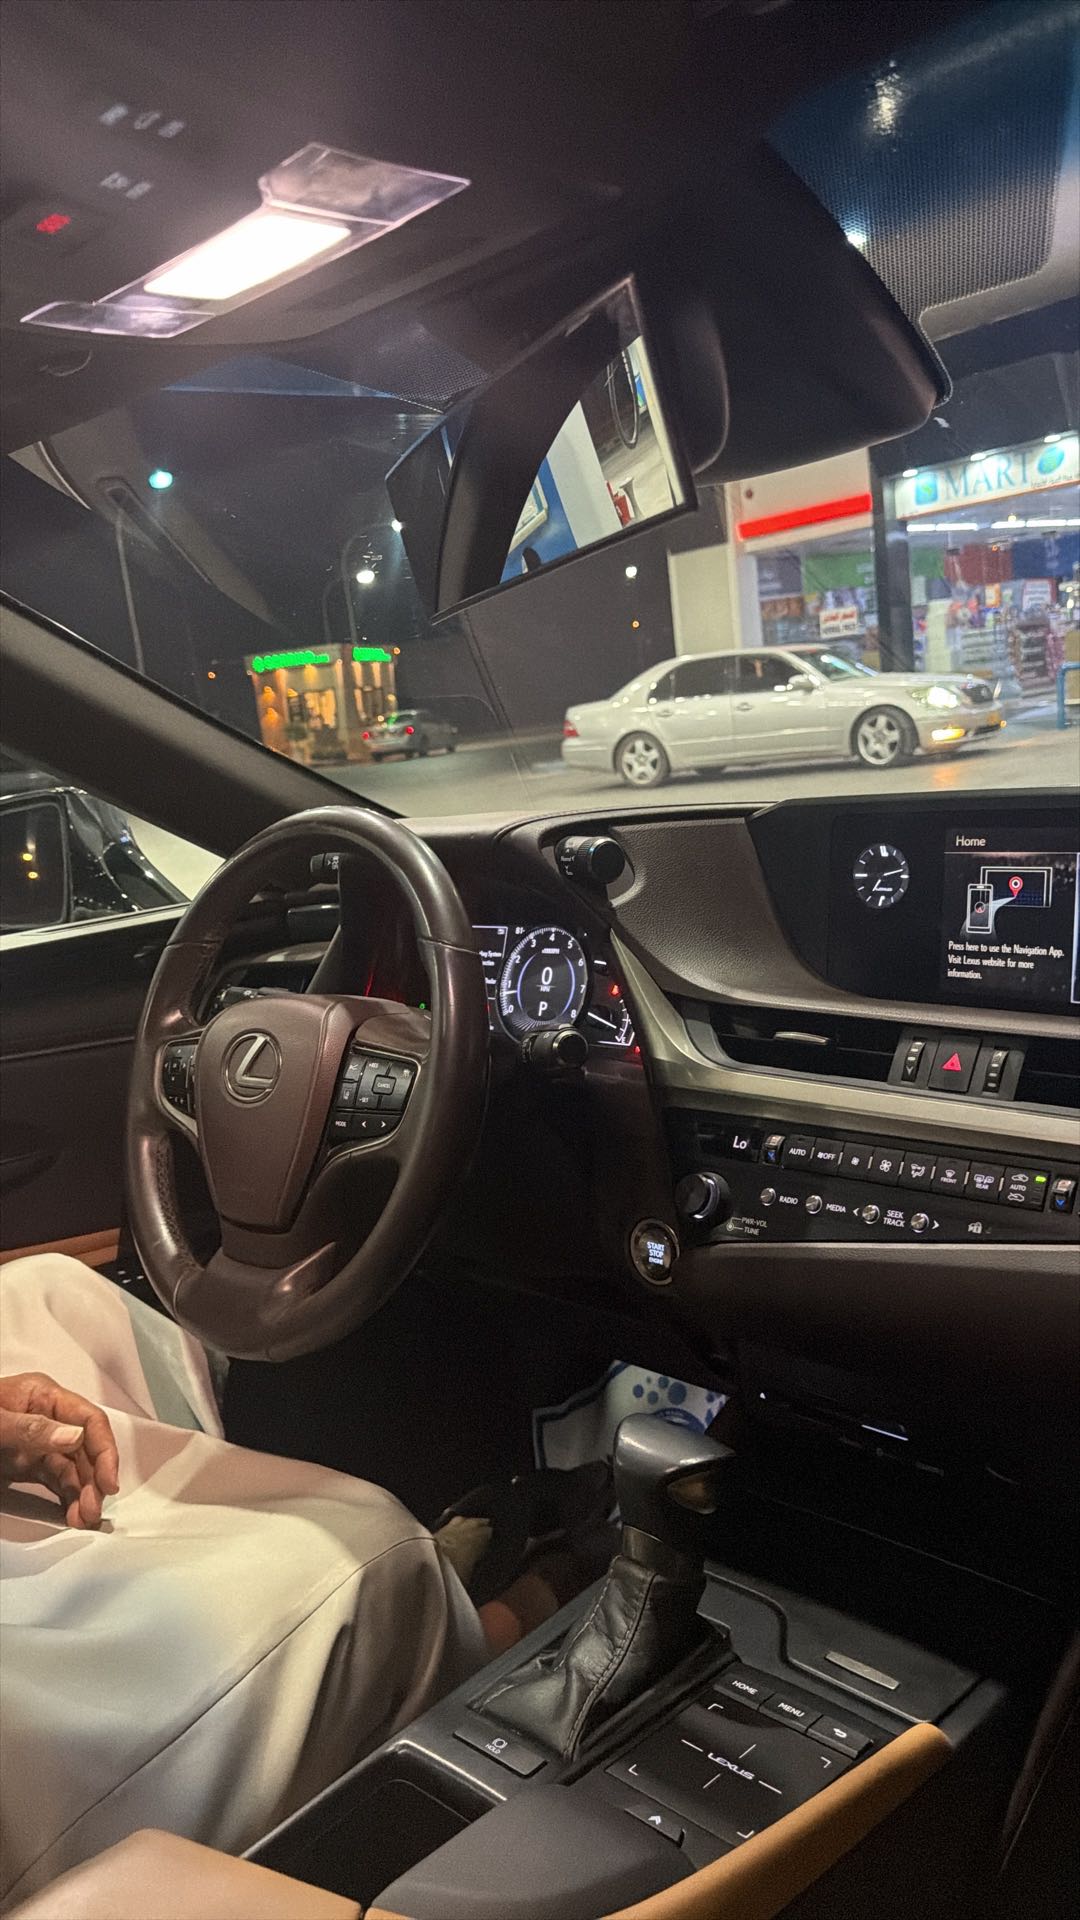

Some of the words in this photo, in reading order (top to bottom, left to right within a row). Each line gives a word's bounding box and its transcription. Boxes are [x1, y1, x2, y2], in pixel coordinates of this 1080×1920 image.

[944, 452, 1032, 500] MART
[955, 835, 986, 847] Home
[530, 939, 537, 948] 3
[549, 934, 556, 943] 4
[567, 939, 573, 949] 5
[948, 940, 964, 951] Press
[966, 942, 979, 952] here
[981, 943, 988, 952] to
[989, 945, 1000, 953] use
[1001, 944, 1012, 954] the
[1014, 944, 1047, 957] Navigation
[1048, 946, 1065, 959] App.
[514, 955, 521, 964] 2
[578, 958, 584, 967] 6
[948, 954, 961, 964] Visit
[963, 955, 980, 966] Lexus
[982, 957, 1006, 967] website
[1007, 958, 1016, 968] for
[1018, 961, 1034, 969] more
[541, 966, 553, 986] 0
[947, 968, 982, 980] information.
[507, 979, 512, 988] 1
[580, 985, 586, 994] 7
[508, 1005, 514, 1014] 0
[538, 1001, 549, 1017] P
[570, 1010, 577, 1019] 8
[733, 1136, 748, 1150] Lo
[789, 1147, 806, 1157] AUTO
[822, 1151, 836, 1162] OFF
[940, 1176, 957, 1185] FRONT
[975, 1182, 989, 1191] REAR
[1009, 1183, 1027, 1192] AUTO
[779, 1195, 798, 1206] RADIO
[826, 1203, 847, 1214] MEDIA
[886, 1208, 904, 1219] SEEK
[741, 1217, 768, 1228] PWR-VOL
[883, 1217, 906, 1228] TRACK
[743, 1226, 761, 1236] TUNE
[647, 1241, 664, 1251] START
[649, 1249, 664, 1258] STOP
[731, 1679, 759, 1695] HOME
[776, 1701, 806, 1718] MENU
[485, 1743, 502, 1754] HOLD
[708, 1752, 755, 1781] LEXUS
